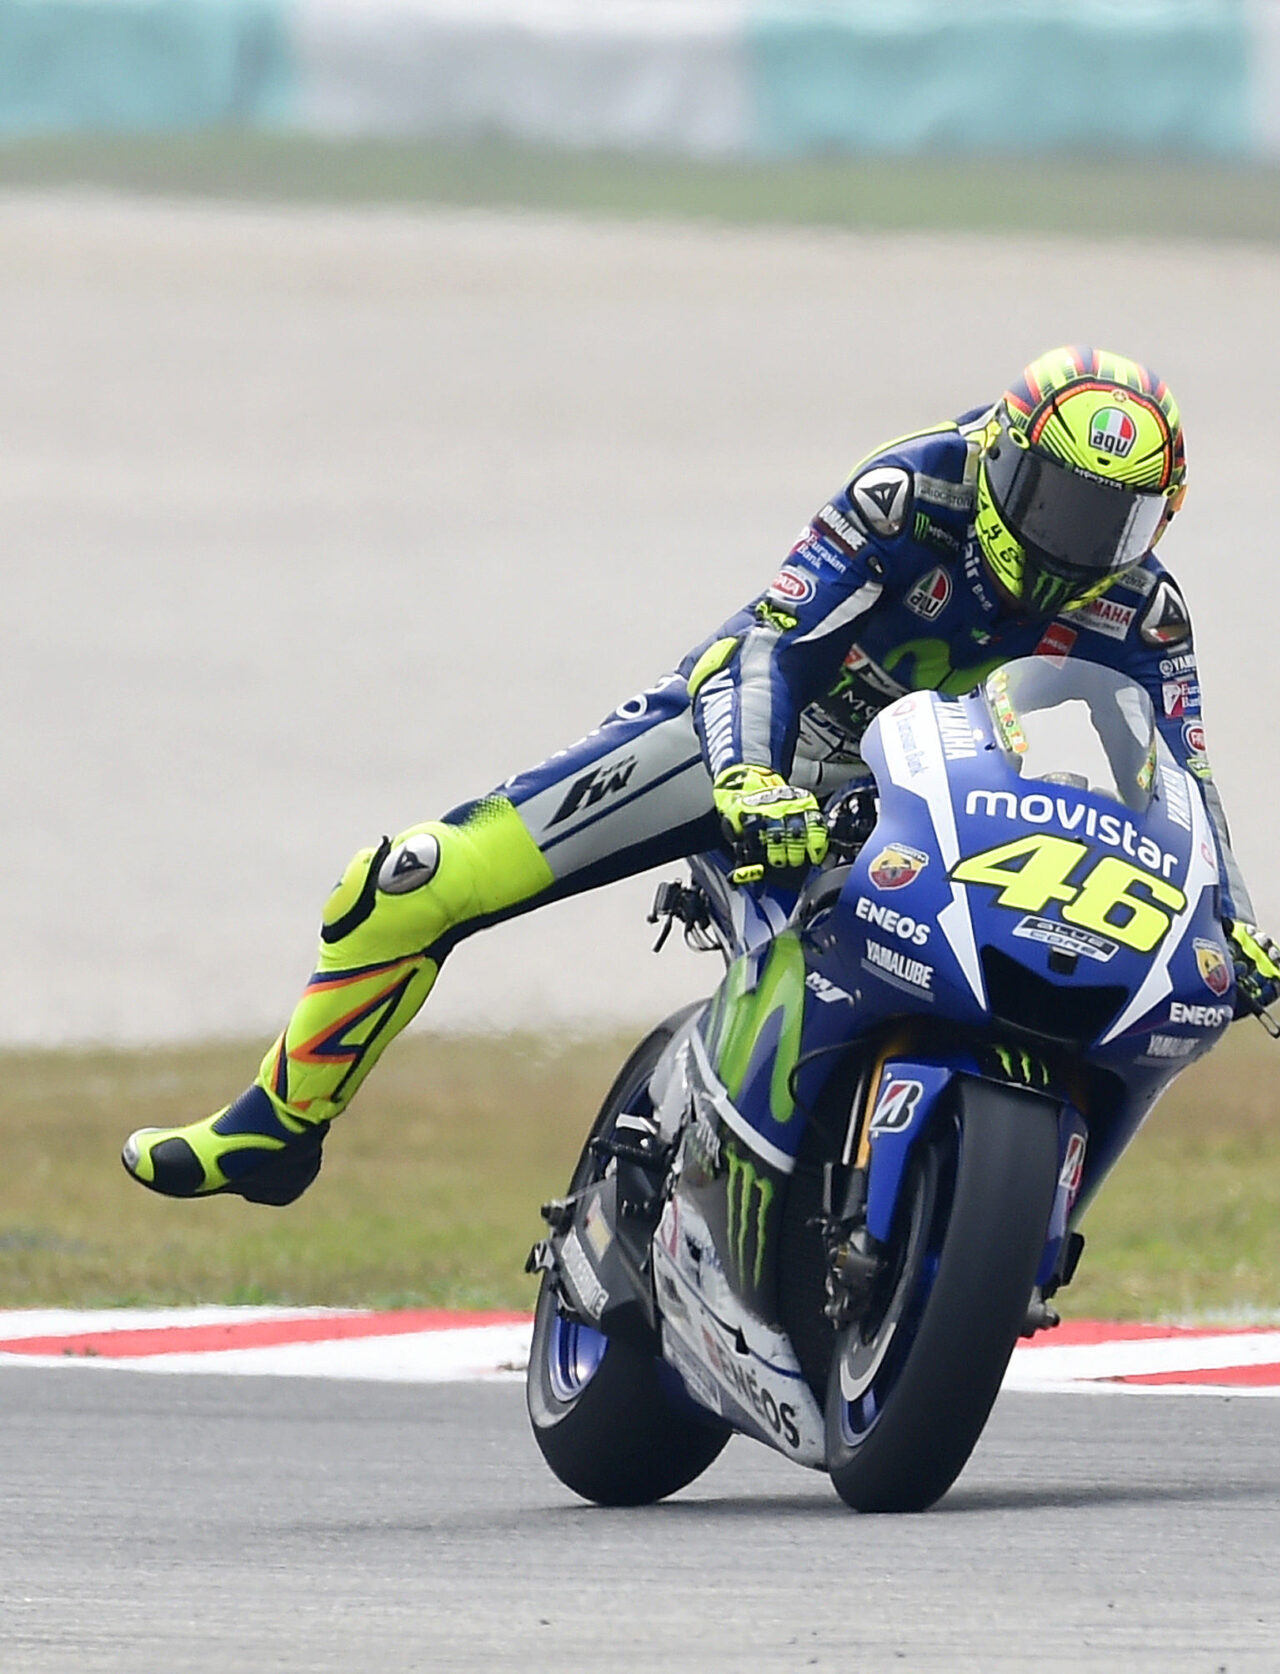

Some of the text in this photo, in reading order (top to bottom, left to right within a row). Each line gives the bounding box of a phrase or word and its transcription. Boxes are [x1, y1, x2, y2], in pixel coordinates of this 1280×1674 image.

[1093, 431, 1128, 455] agv
[797, 544, 823, 571] Bank
[805, 533, 847, 575] Eurasian
[934, 701, 978, 761] YAMAHA
[966, 790, 1179, 878] movistar
[951, 832, 1188, 953] 46
[855, 896, 932, 946] ENEOS
[866, 938, 935, 989] YAMALUBE
[1169, 1002, 1224, 1028] ENEOS
